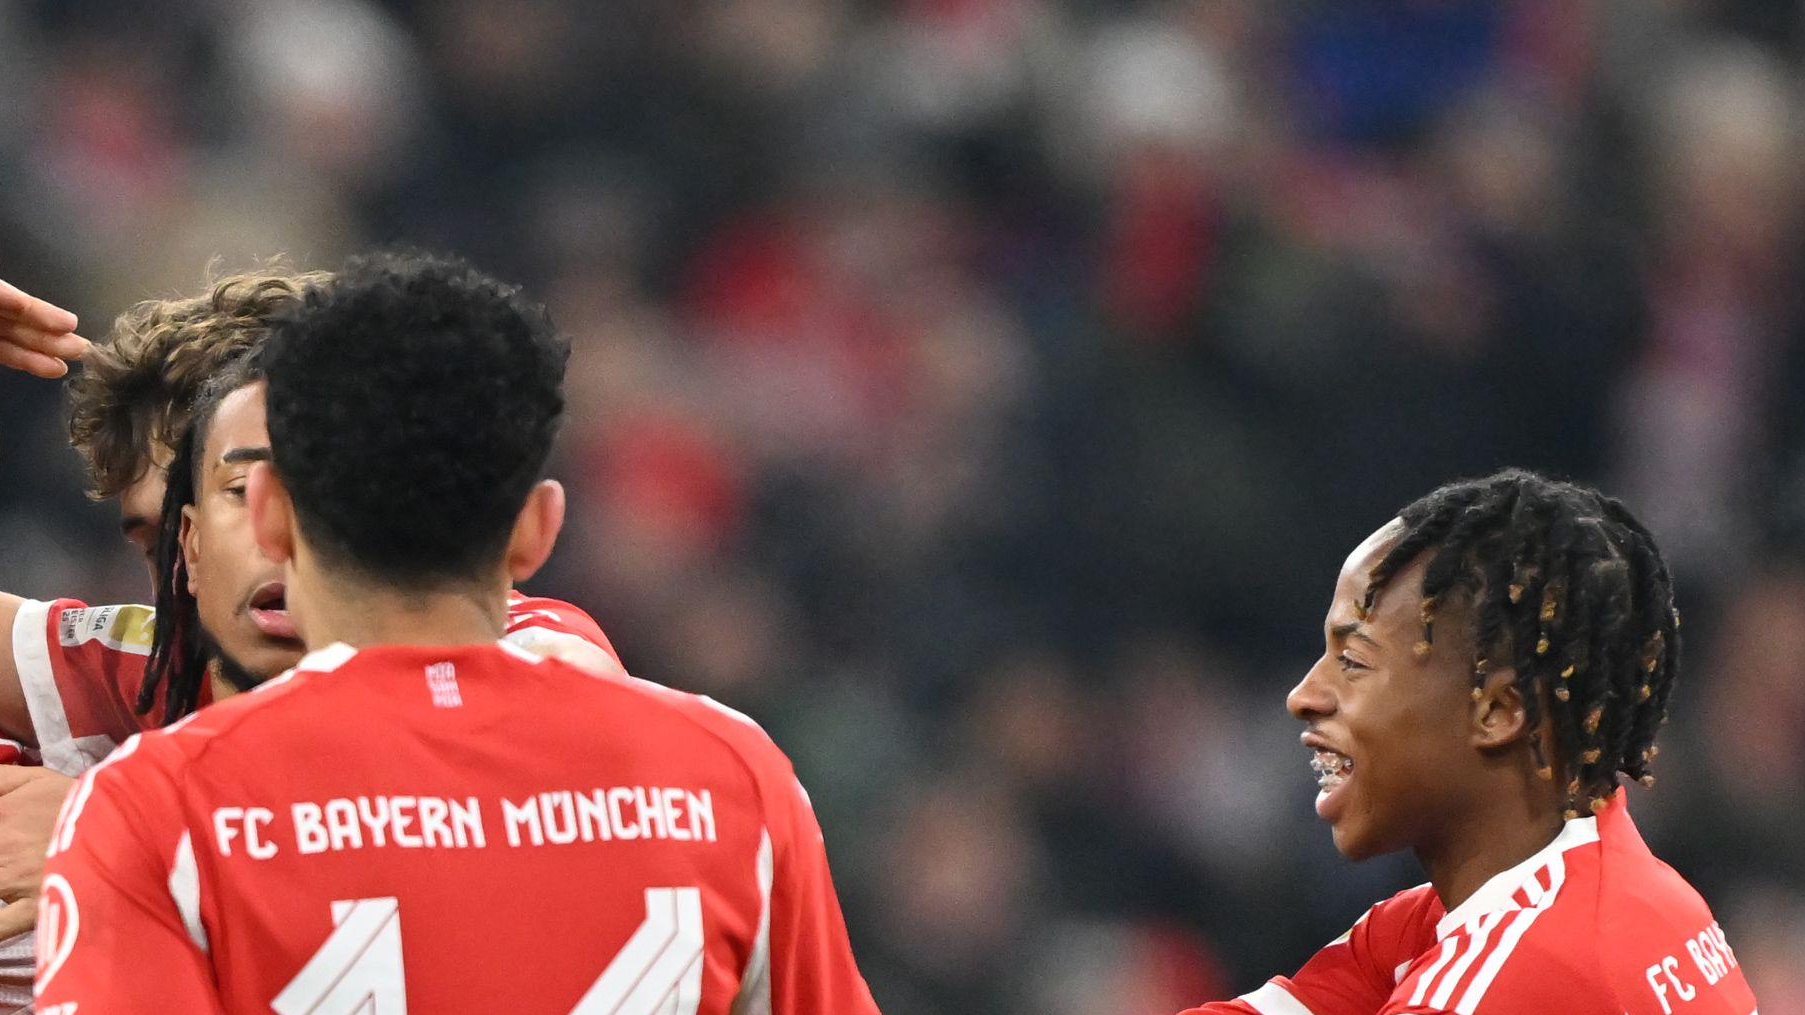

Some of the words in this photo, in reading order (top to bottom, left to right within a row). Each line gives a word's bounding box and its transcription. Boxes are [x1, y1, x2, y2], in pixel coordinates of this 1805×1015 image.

[213, 807, 278, 860] FC
[291, 796, 486, 854] BAYERN
[502, 786, 717, 848] MÜNCHEN
[1645, 955, 1696, 1015] FC
